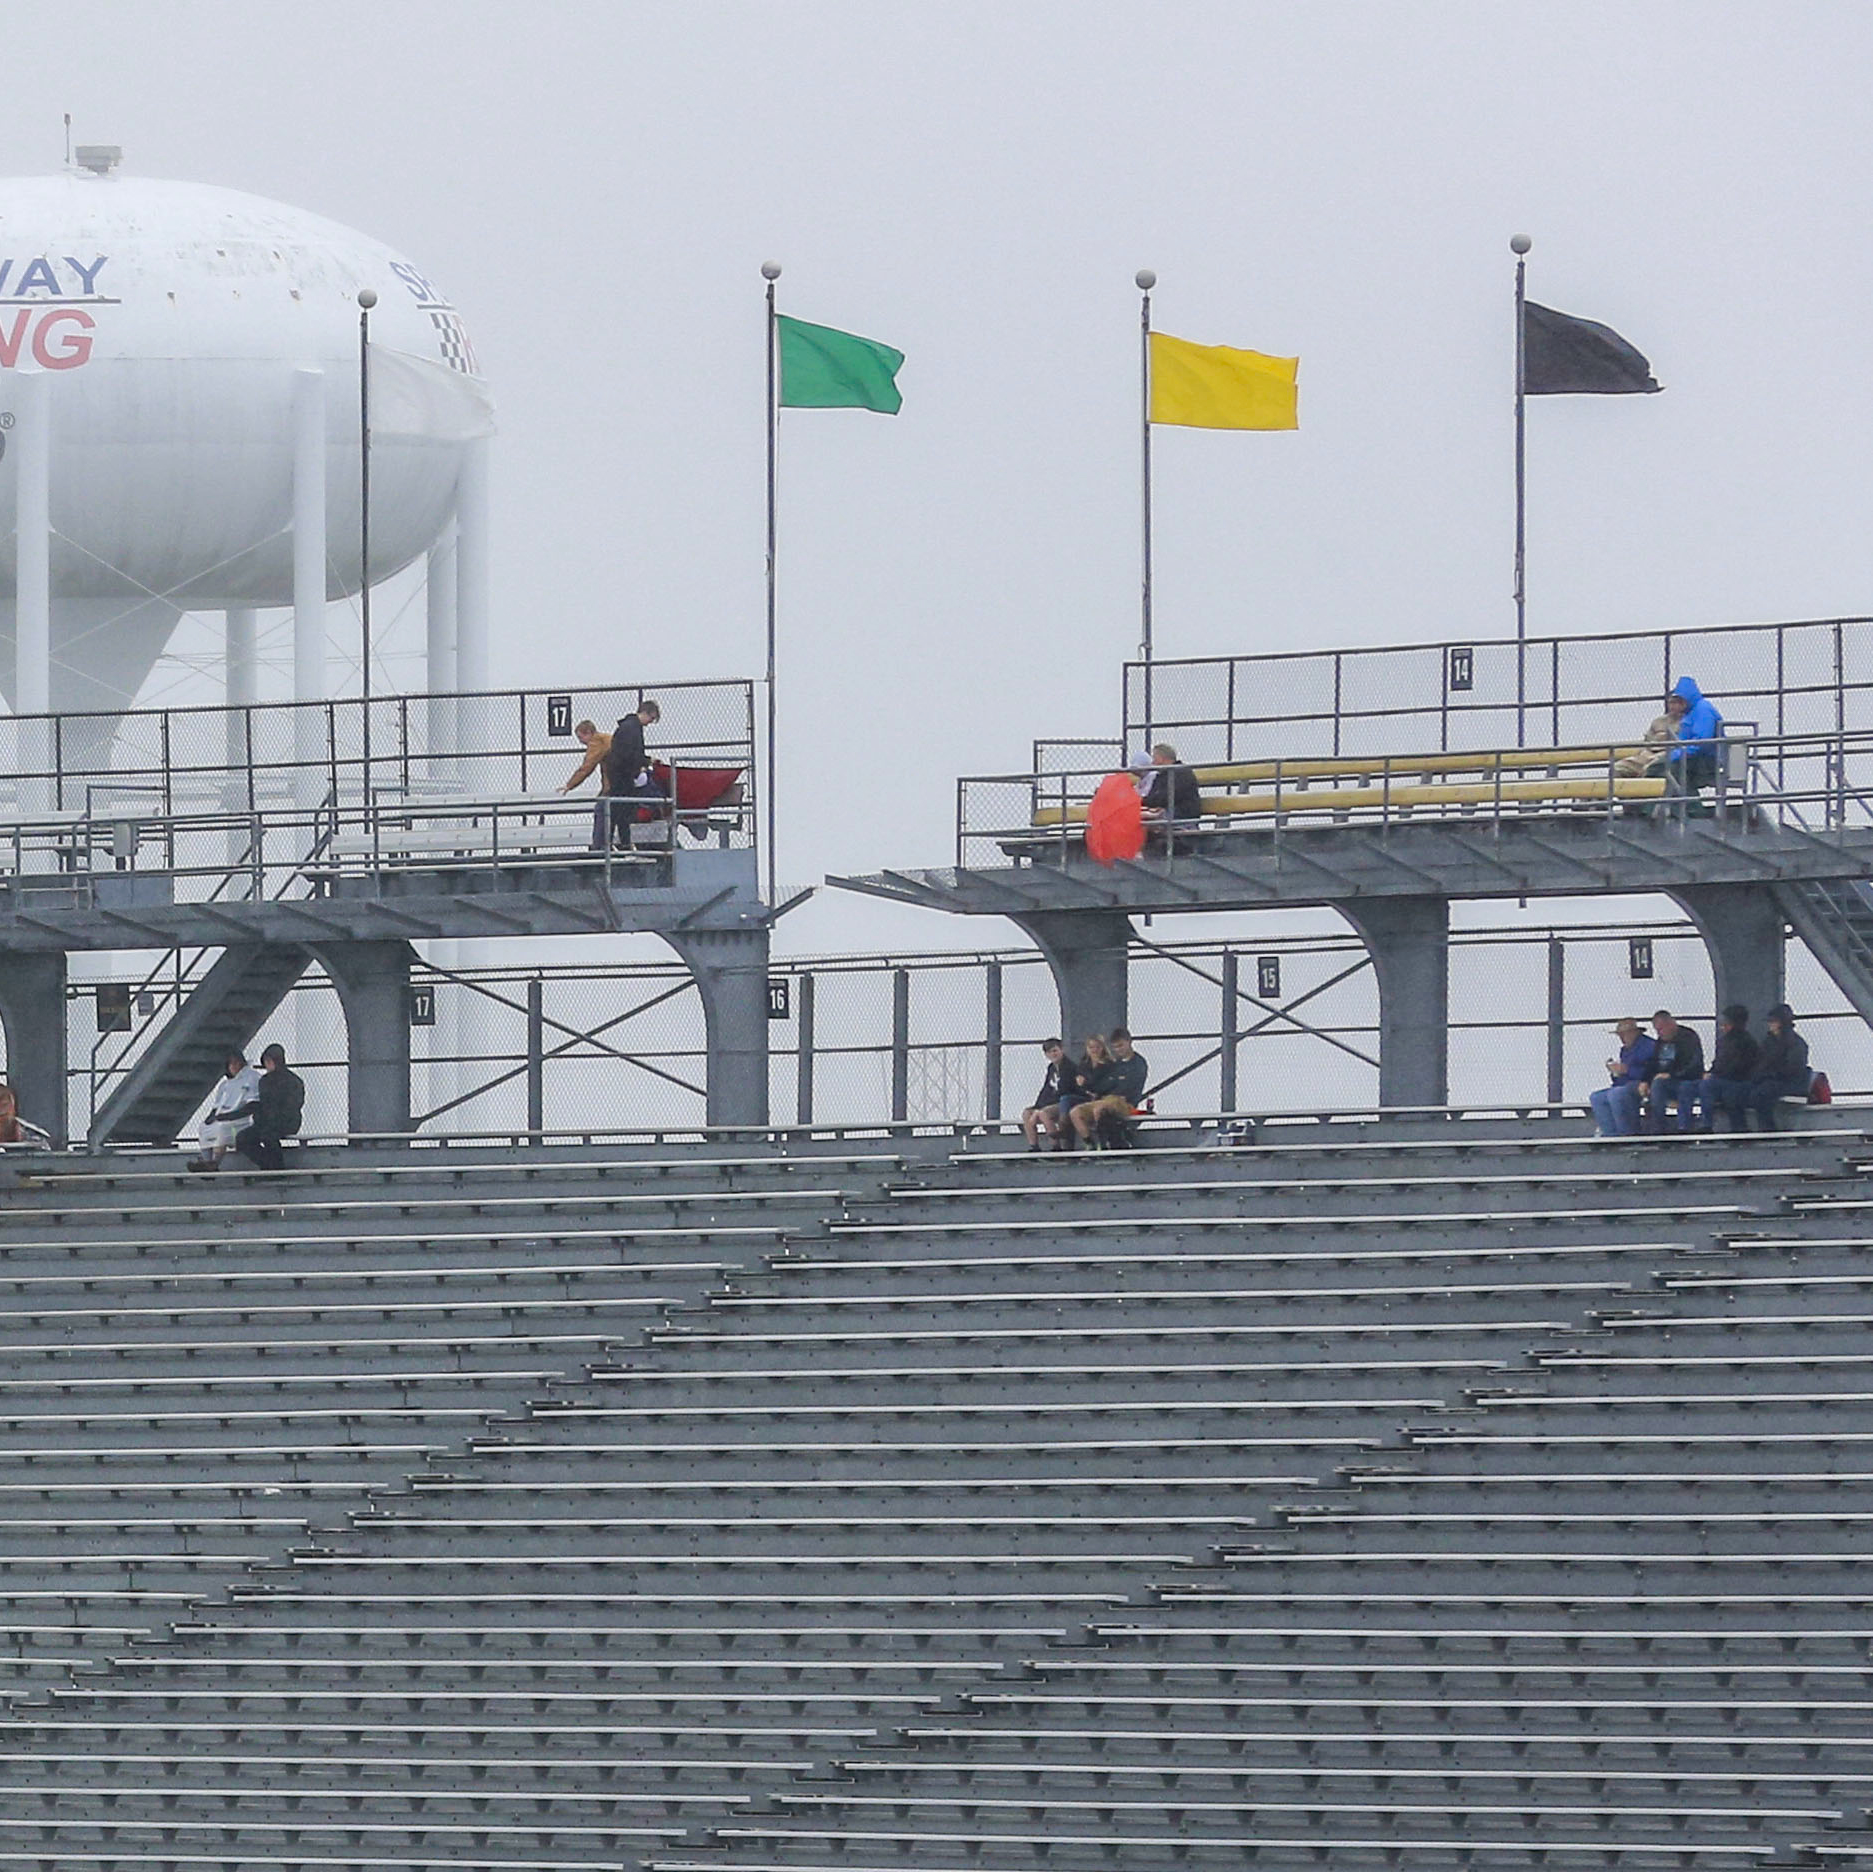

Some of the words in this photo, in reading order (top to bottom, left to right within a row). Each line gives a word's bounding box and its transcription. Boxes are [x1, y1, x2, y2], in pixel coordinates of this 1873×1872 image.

[1455, 659, 1469, 682] 14
[553, 706, 567, 728] 17
[1635, 947, 1649, 969] 14
[1262, 967, 1277, 989] 15
[416, 996, 430, 1016] 17
[770, 989, 785, 1010] 16
